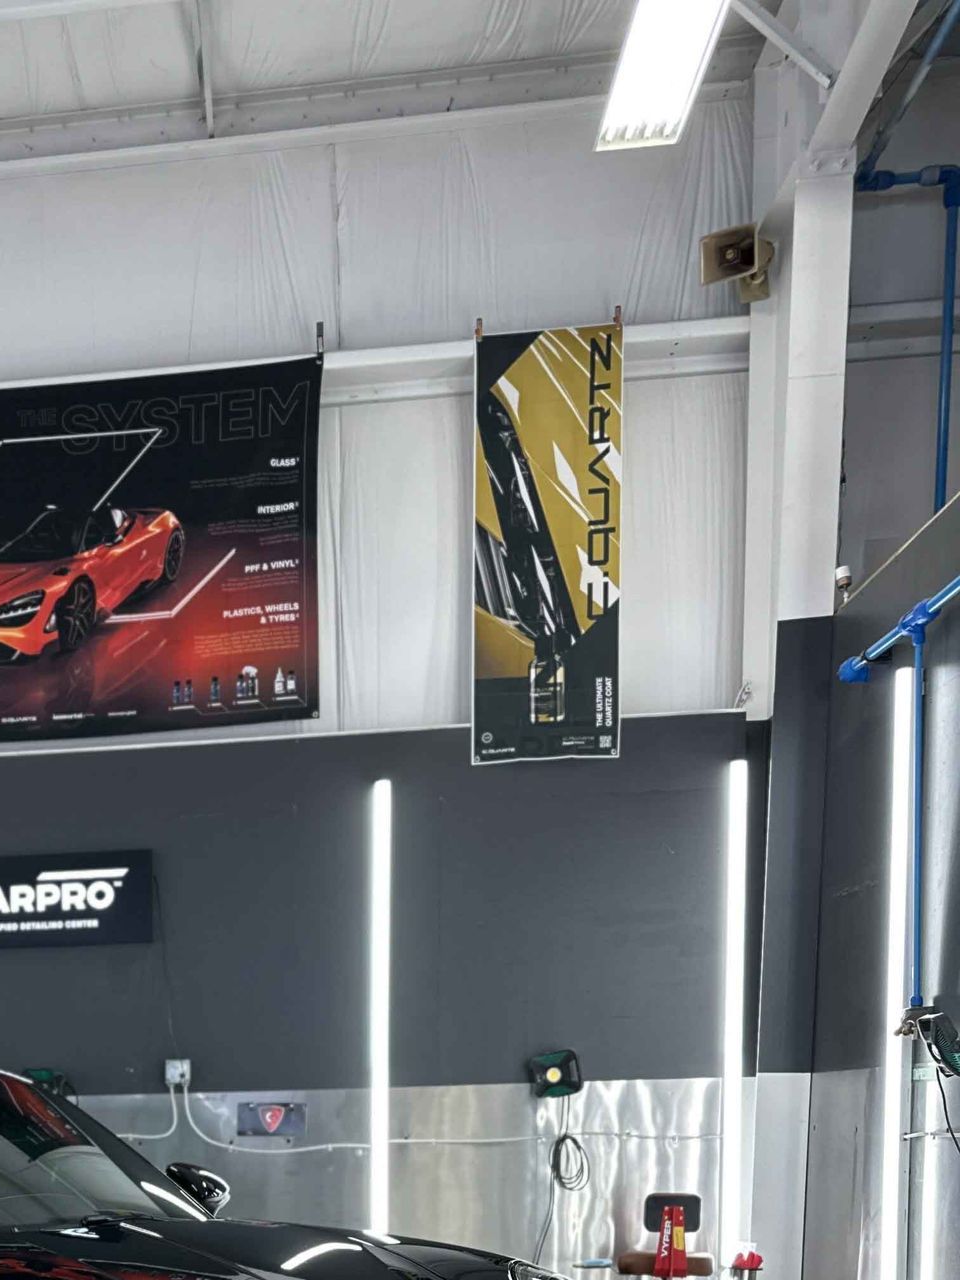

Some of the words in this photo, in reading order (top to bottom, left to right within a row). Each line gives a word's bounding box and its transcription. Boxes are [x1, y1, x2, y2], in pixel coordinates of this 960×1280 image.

[17, 407, 57, 427] THE
[61, 381, 310, 455] SYSTEM
[588, 334, 616, 620] C.QUARTZ
[244, 564, 260, 574] PPF
[261, 562, 269, 571] &
[264, 602, 300, 613] WHEELS
[259, 615, 268, 624] &
[595, 676, 604, 711] ULTIMATE
[604, 676, 613, 697] COAT
[595, 712, 604, 728] THE
[604, 697, 614, 727] QUARTZ
[20, 920, 64, 931] DETAILING
[65, 918, 100, 929] CENTER
[661, 1220, 672, 1257] VYPER
